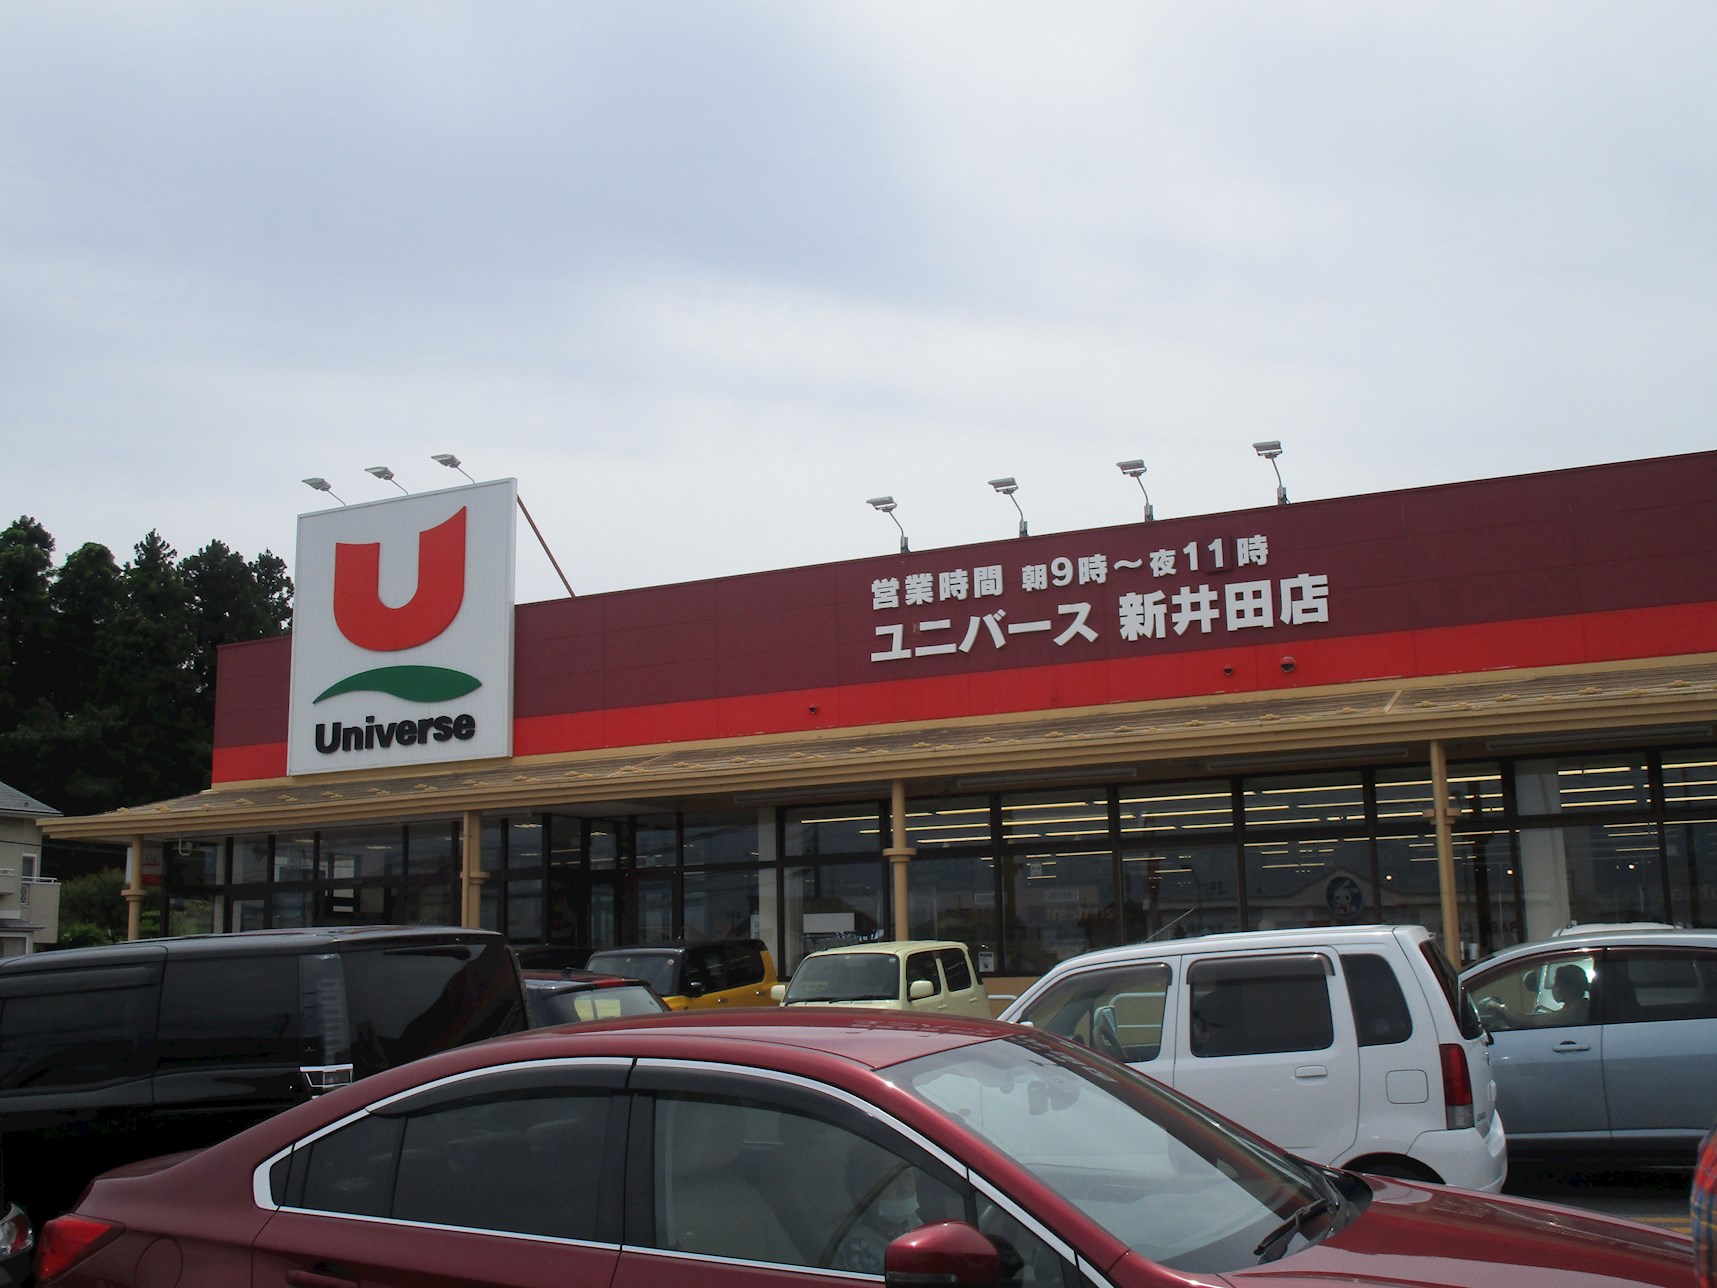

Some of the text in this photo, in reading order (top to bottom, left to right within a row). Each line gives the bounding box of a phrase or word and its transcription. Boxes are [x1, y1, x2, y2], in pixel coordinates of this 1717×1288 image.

[333, 506, 467, 652] U
[871, 564, 1004, 611] 営業時間
[870, 573, 1329, 662] ユニバース 新井田店
[315, 713, 476, 754] Universe
